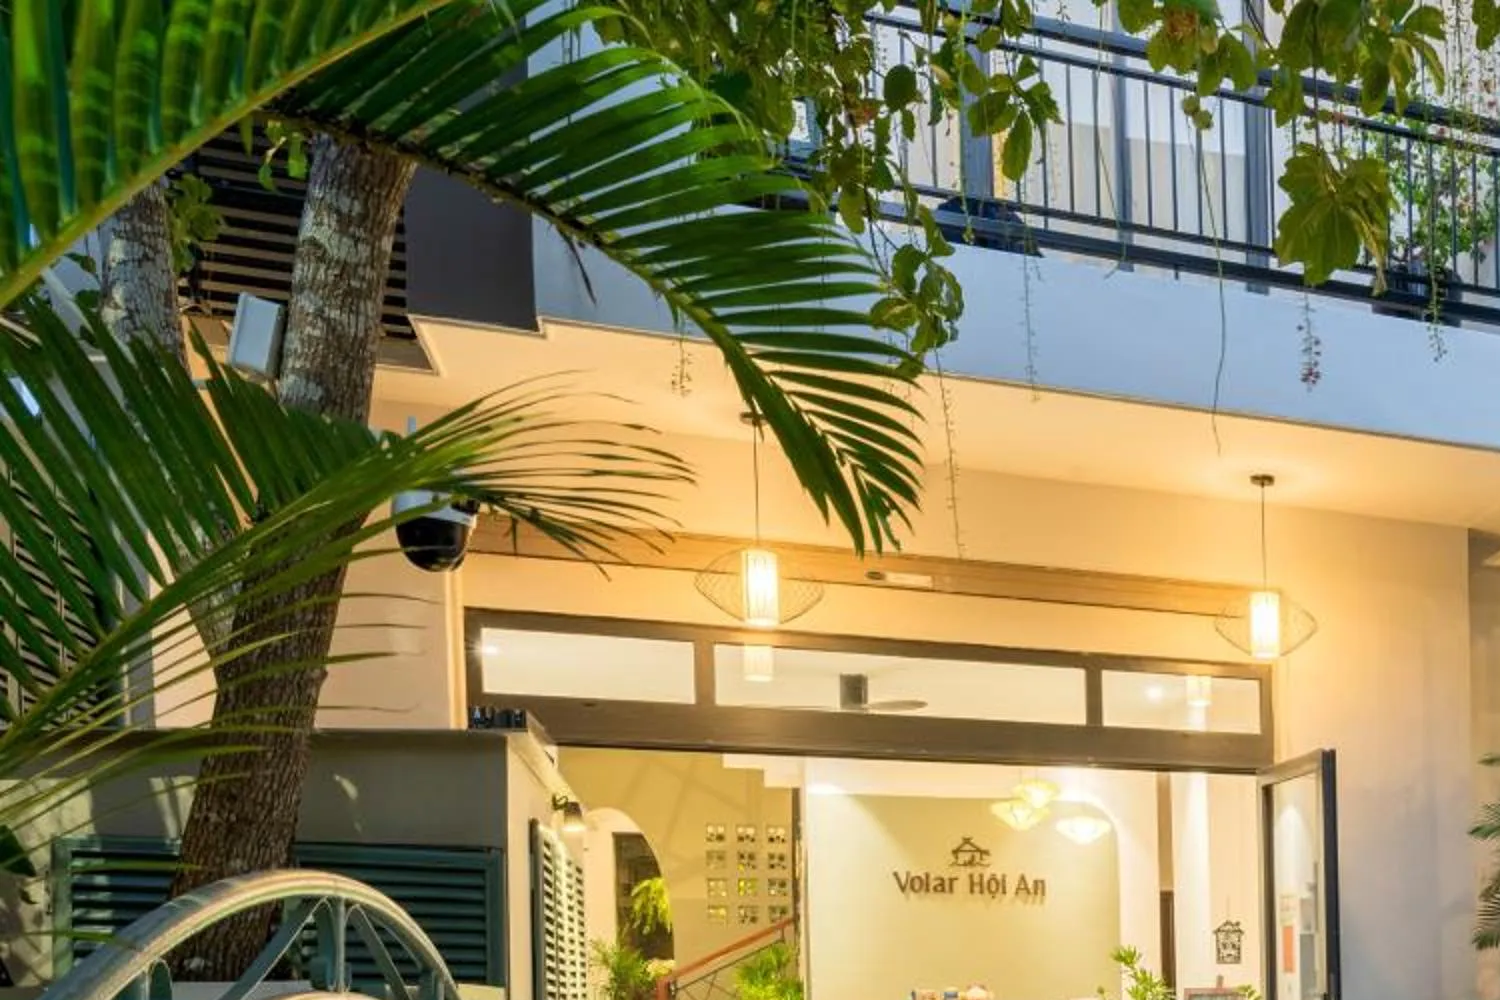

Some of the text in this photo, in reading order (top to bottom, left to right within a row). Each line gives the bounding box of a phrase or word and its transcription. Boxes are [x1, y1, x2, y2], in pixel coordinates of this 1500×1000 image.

[893, 871, 1047, 899] Volar Hội An
